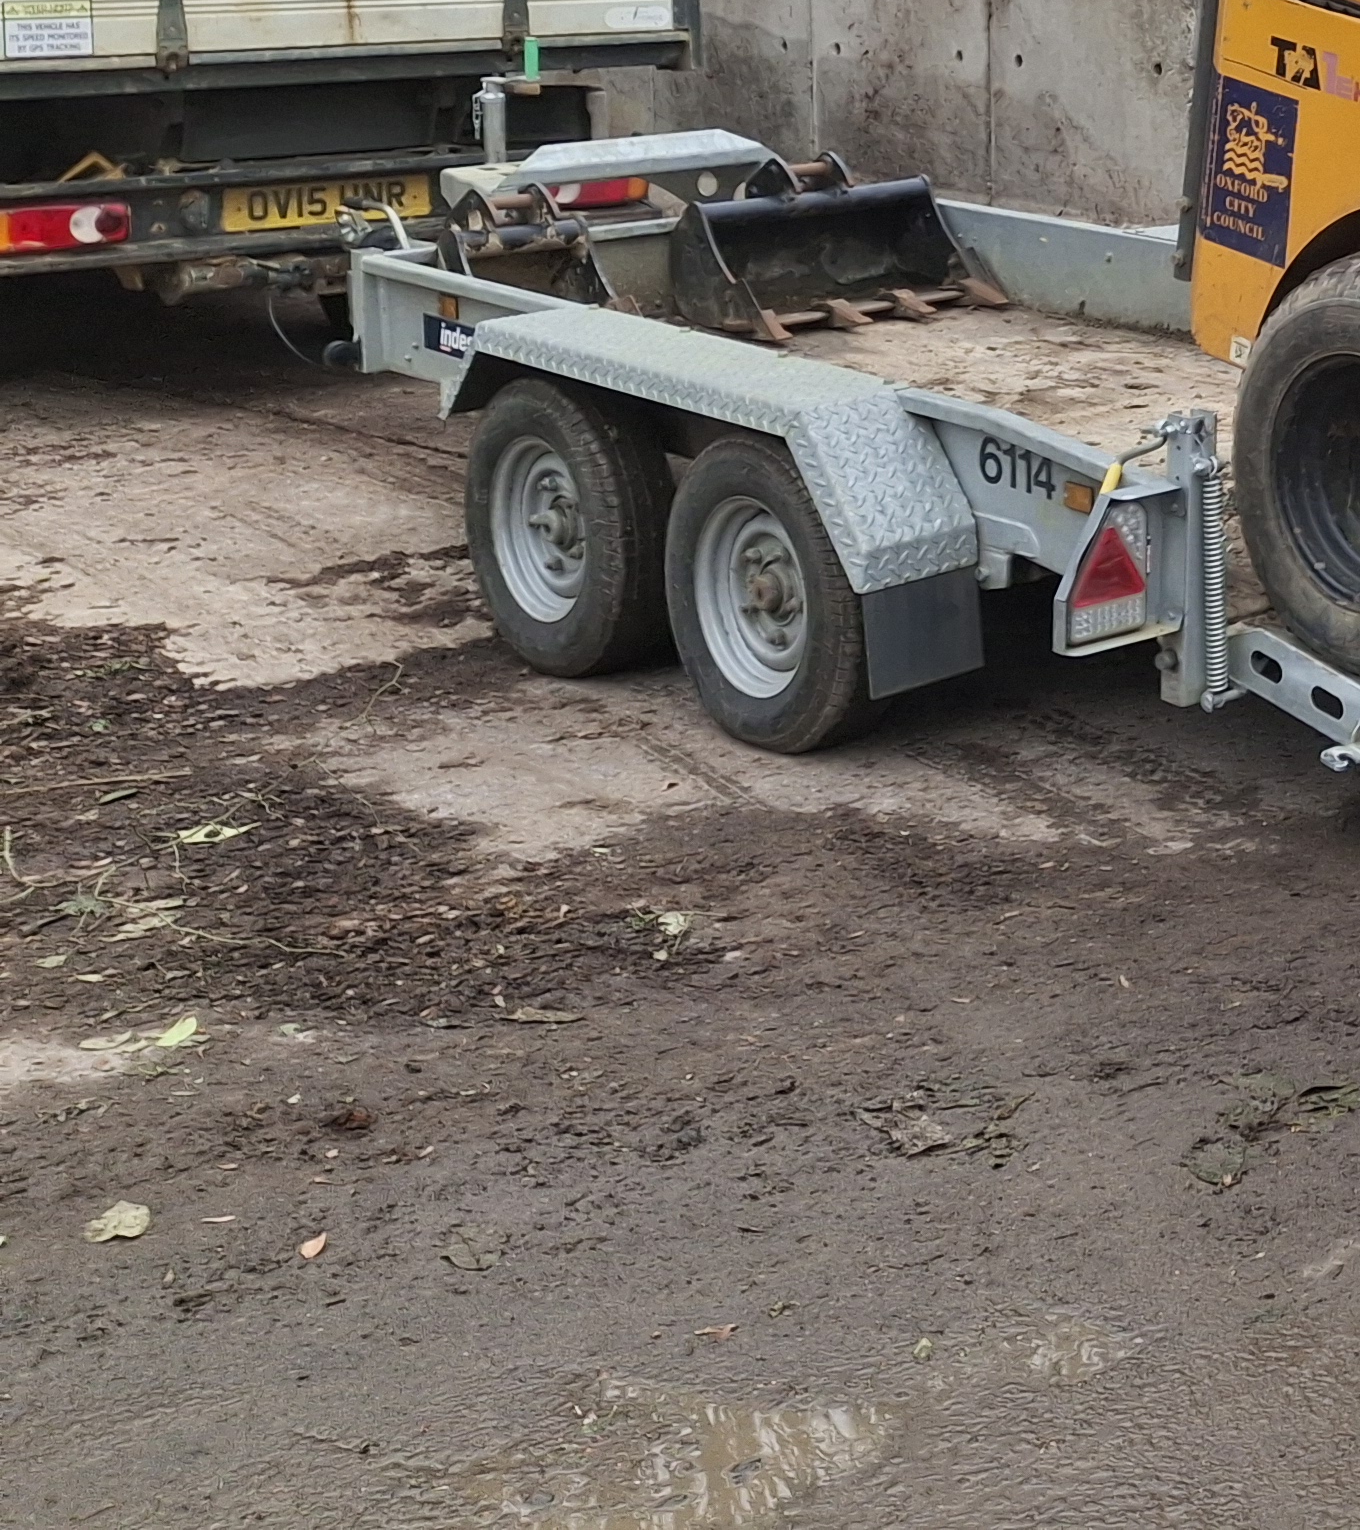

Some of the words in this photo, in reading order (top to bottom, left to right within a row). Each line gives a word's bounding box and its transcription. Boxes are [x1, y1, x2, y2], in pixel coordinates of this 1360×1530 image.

[35, 22, 63, 31] VEHICLE
[247, 186, 328, 222] OV15
[1216, 173, 1268, 204] OXFORD
[1225, 196, 1257, 218] CITY
[1213, 211, 1266, 242] COUNCIL
[980, 435, 1056, 500] 6114
